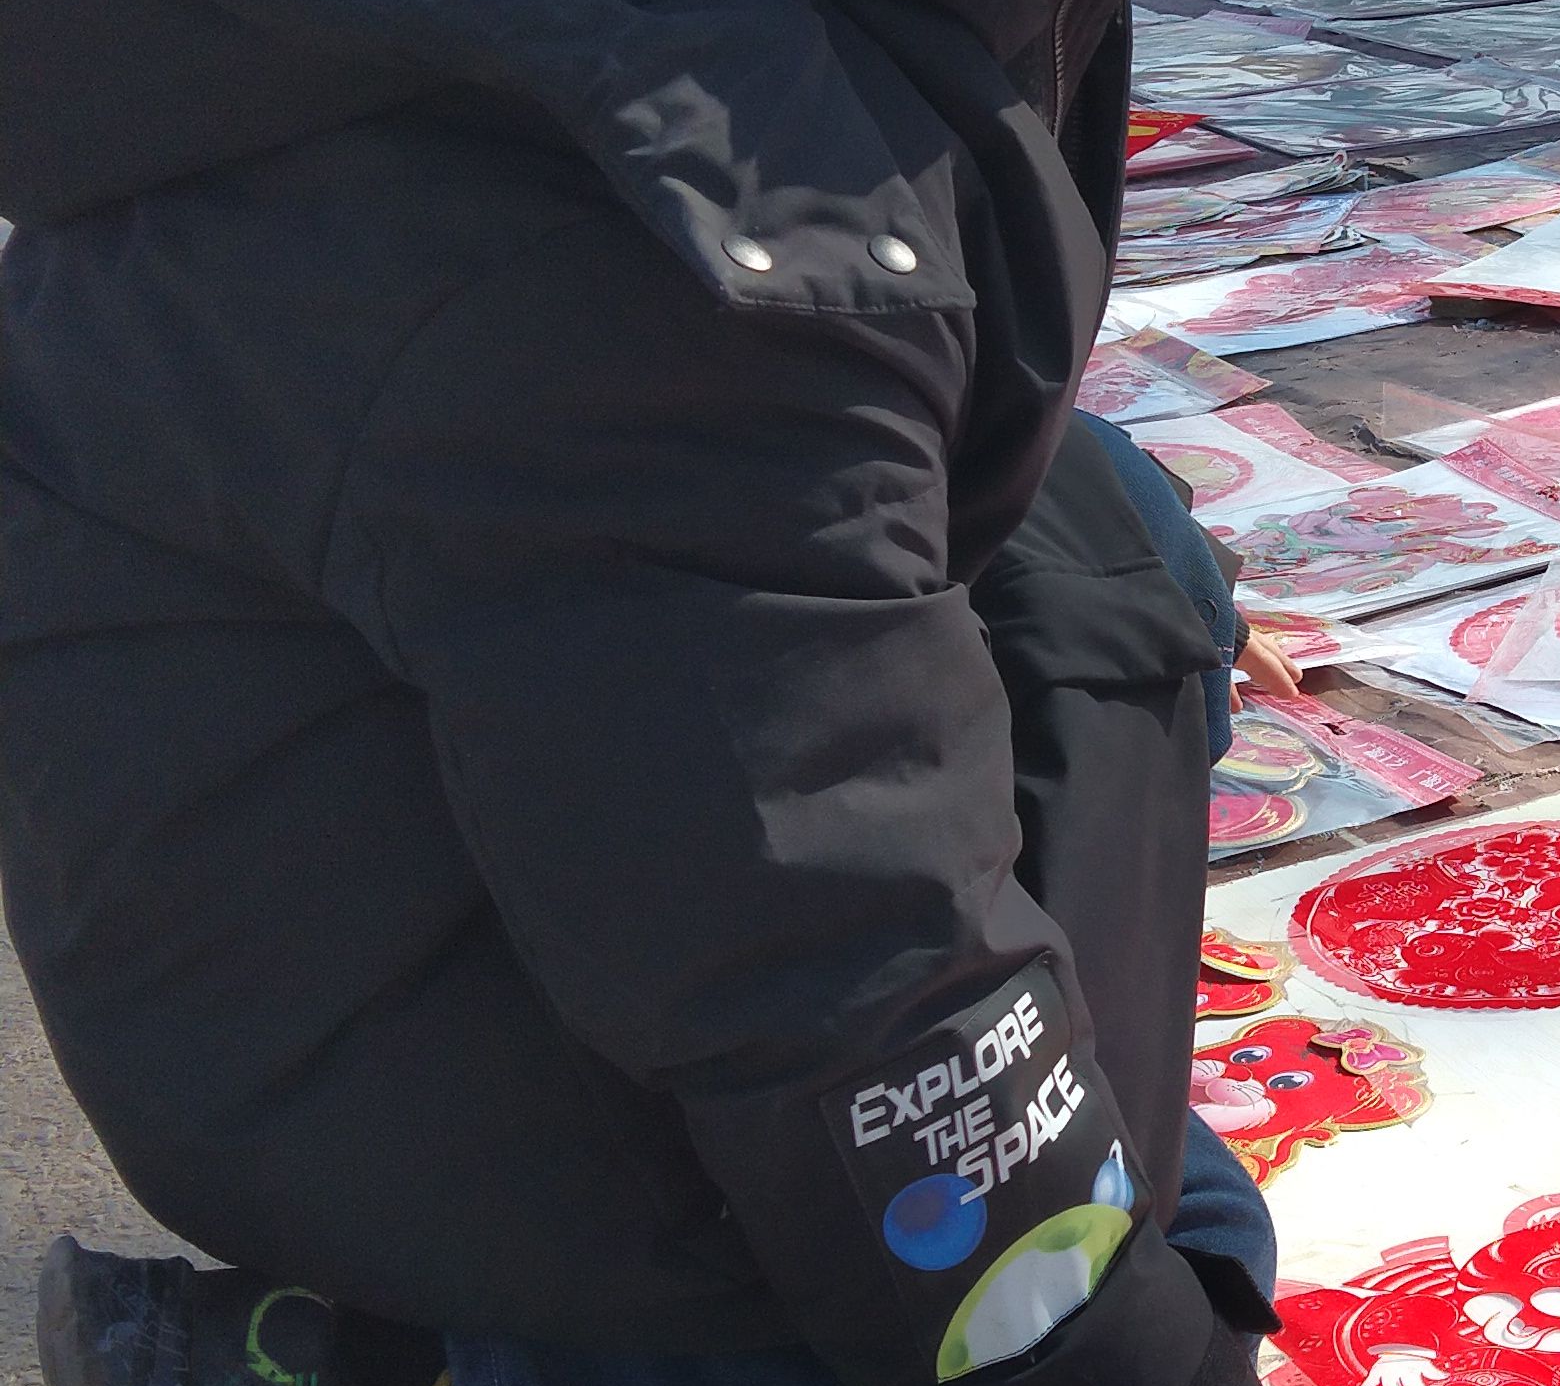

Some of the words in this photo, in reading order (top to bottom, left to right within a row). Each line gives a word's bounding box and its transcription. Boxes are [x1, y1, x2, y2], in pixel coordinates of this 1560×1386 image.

[850, 991, 1045, 1148] EXPLORE
[914, 1093, 996, 1166] THE
[958, 1053, 1085, 1205] SPACE
